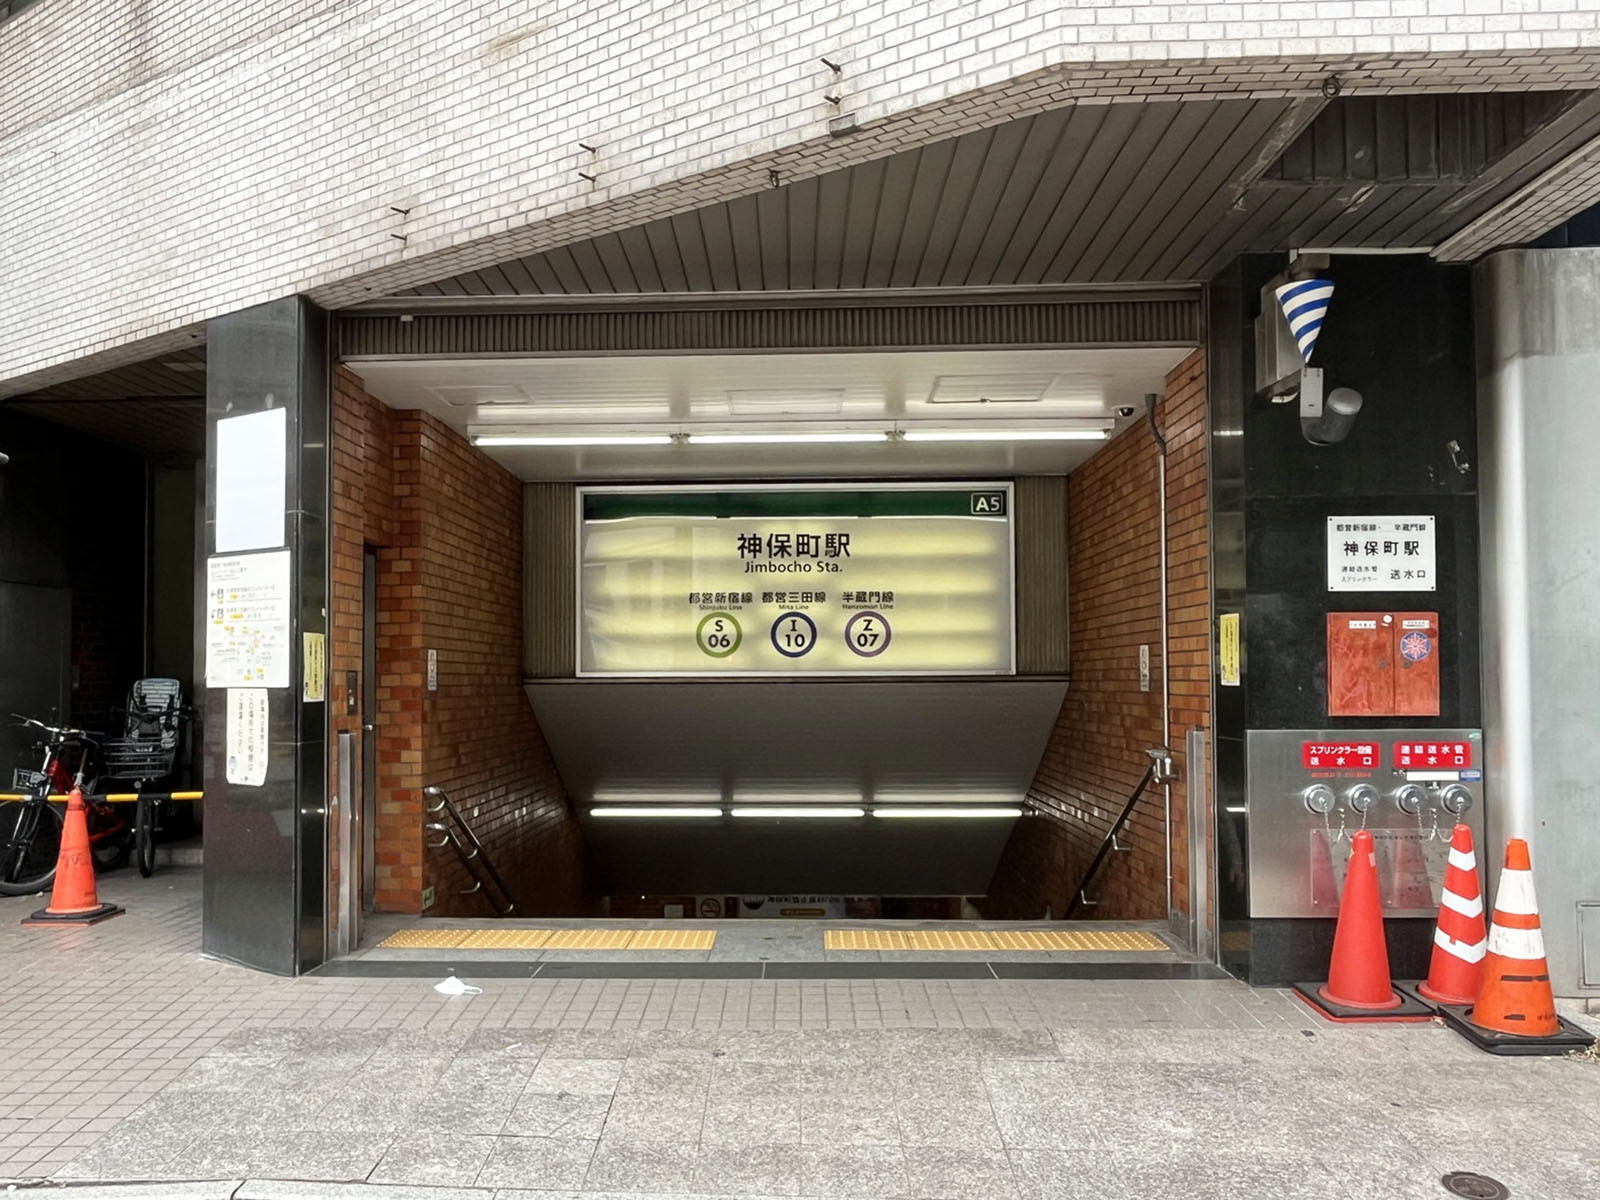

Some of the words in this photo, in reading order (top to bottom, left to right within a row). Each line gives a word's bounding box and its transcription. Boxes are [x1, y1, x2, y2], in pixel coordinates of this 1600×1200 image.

[975, 496, 1000, 511] A5
[737, 533, 850, 559] 神保町駅
[1343, 540, 1420, 556] 神保町駅
[744, 560, 812, 573] Jimbocho
[817, 560, 843, 573] Sta.
[1390, 569, 1426, 580] 送水口
[688, 592, 753, 604] 都営新宿線
[761, 591, 826, 603] 都営三田線
[842, 591, 894, 603] 半蔵門線
[714, 619, 724, 632] S
[789, 619, 798, 632] I
[863, 619, 873, 631] Z
[708, 634, 731, 648] 06
[784, 634, 805, 647] 10
[857, 633, 879, 647] 07
[1310, 745, 1373, 755] スプリンクラー設備
[1310, 756, 1372, 766] 送水口
[1401, 756, 1464, 766] 送水口
